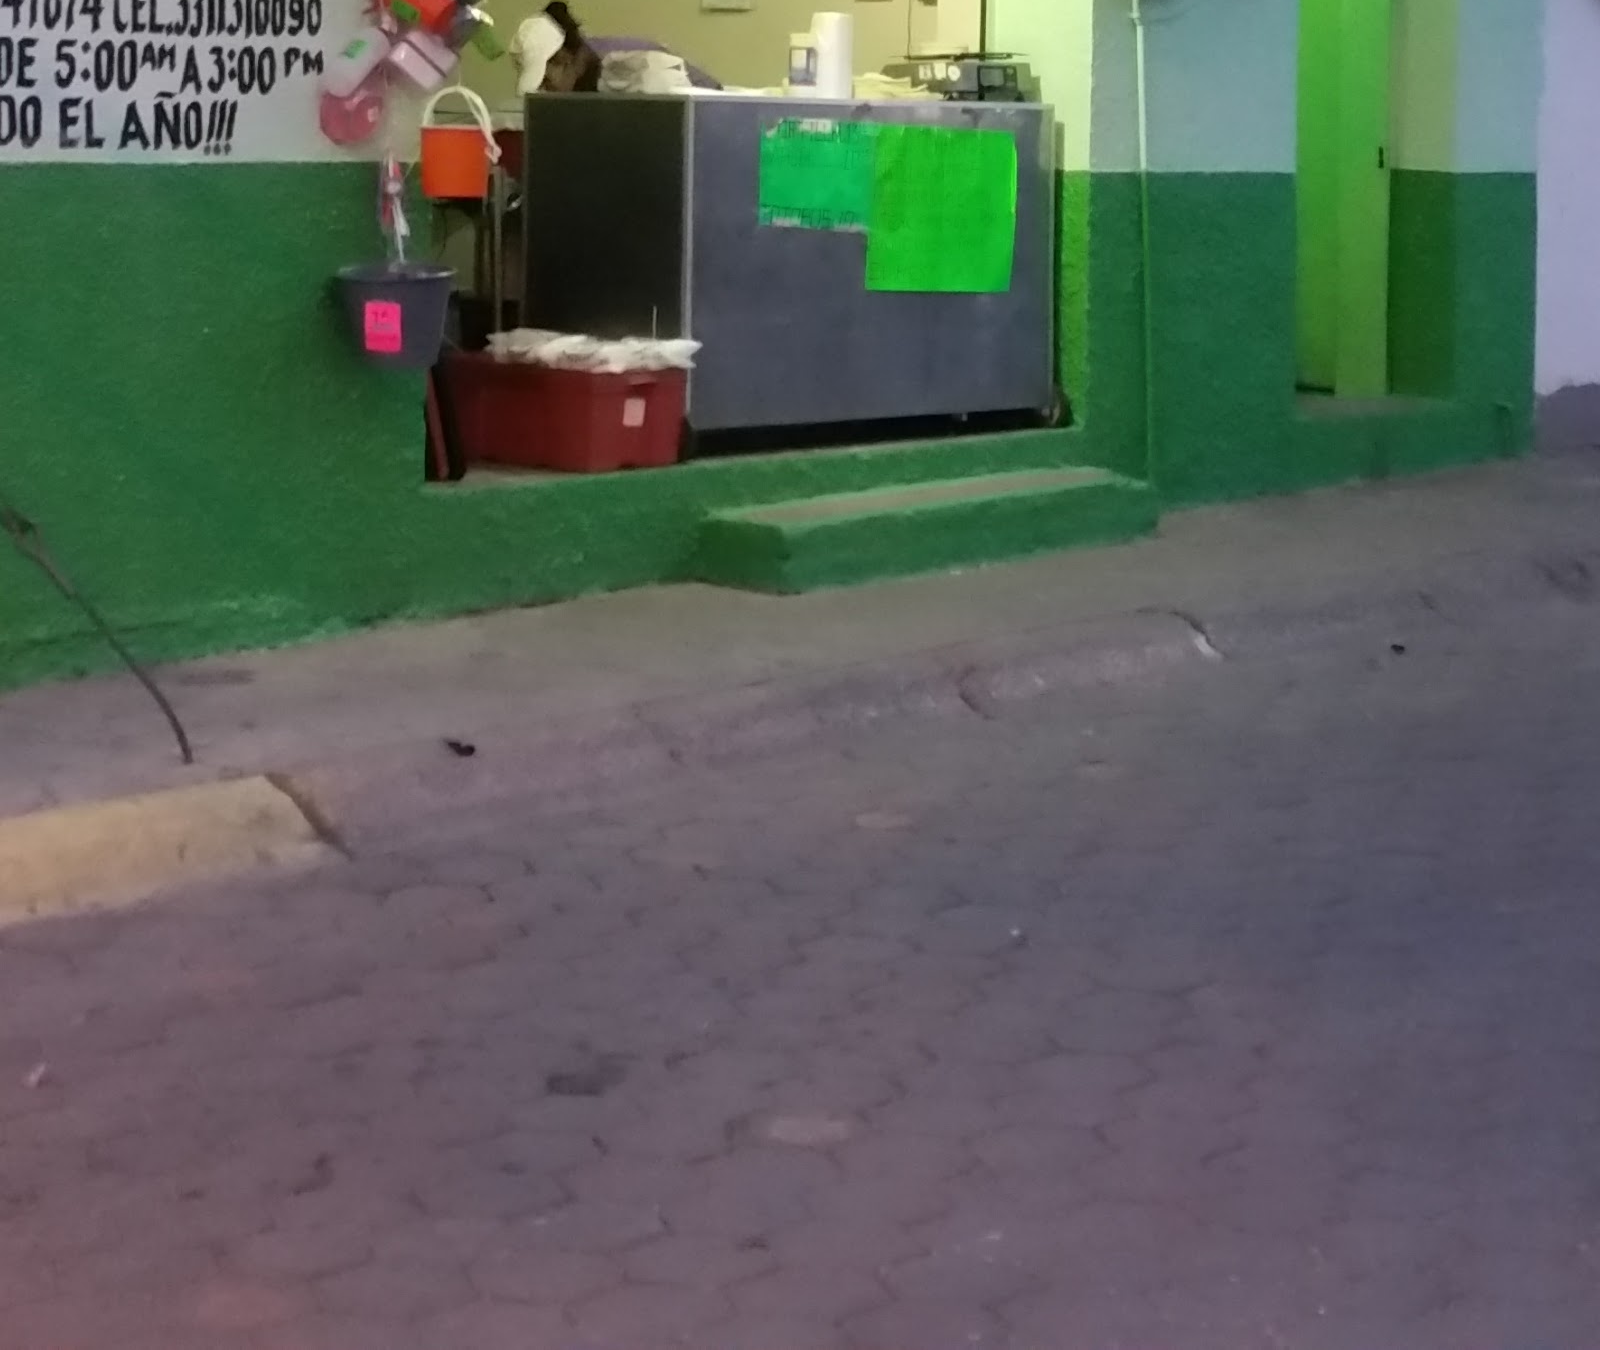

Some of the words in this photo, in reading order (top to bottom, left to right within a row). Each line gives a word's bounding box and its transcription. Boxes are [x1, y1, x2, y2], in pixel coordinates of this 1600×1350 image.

[179, 44, 203, 95] A
[58, 96, 105, 150] EL
[117, 90, 238, 156] AÑO!!!
